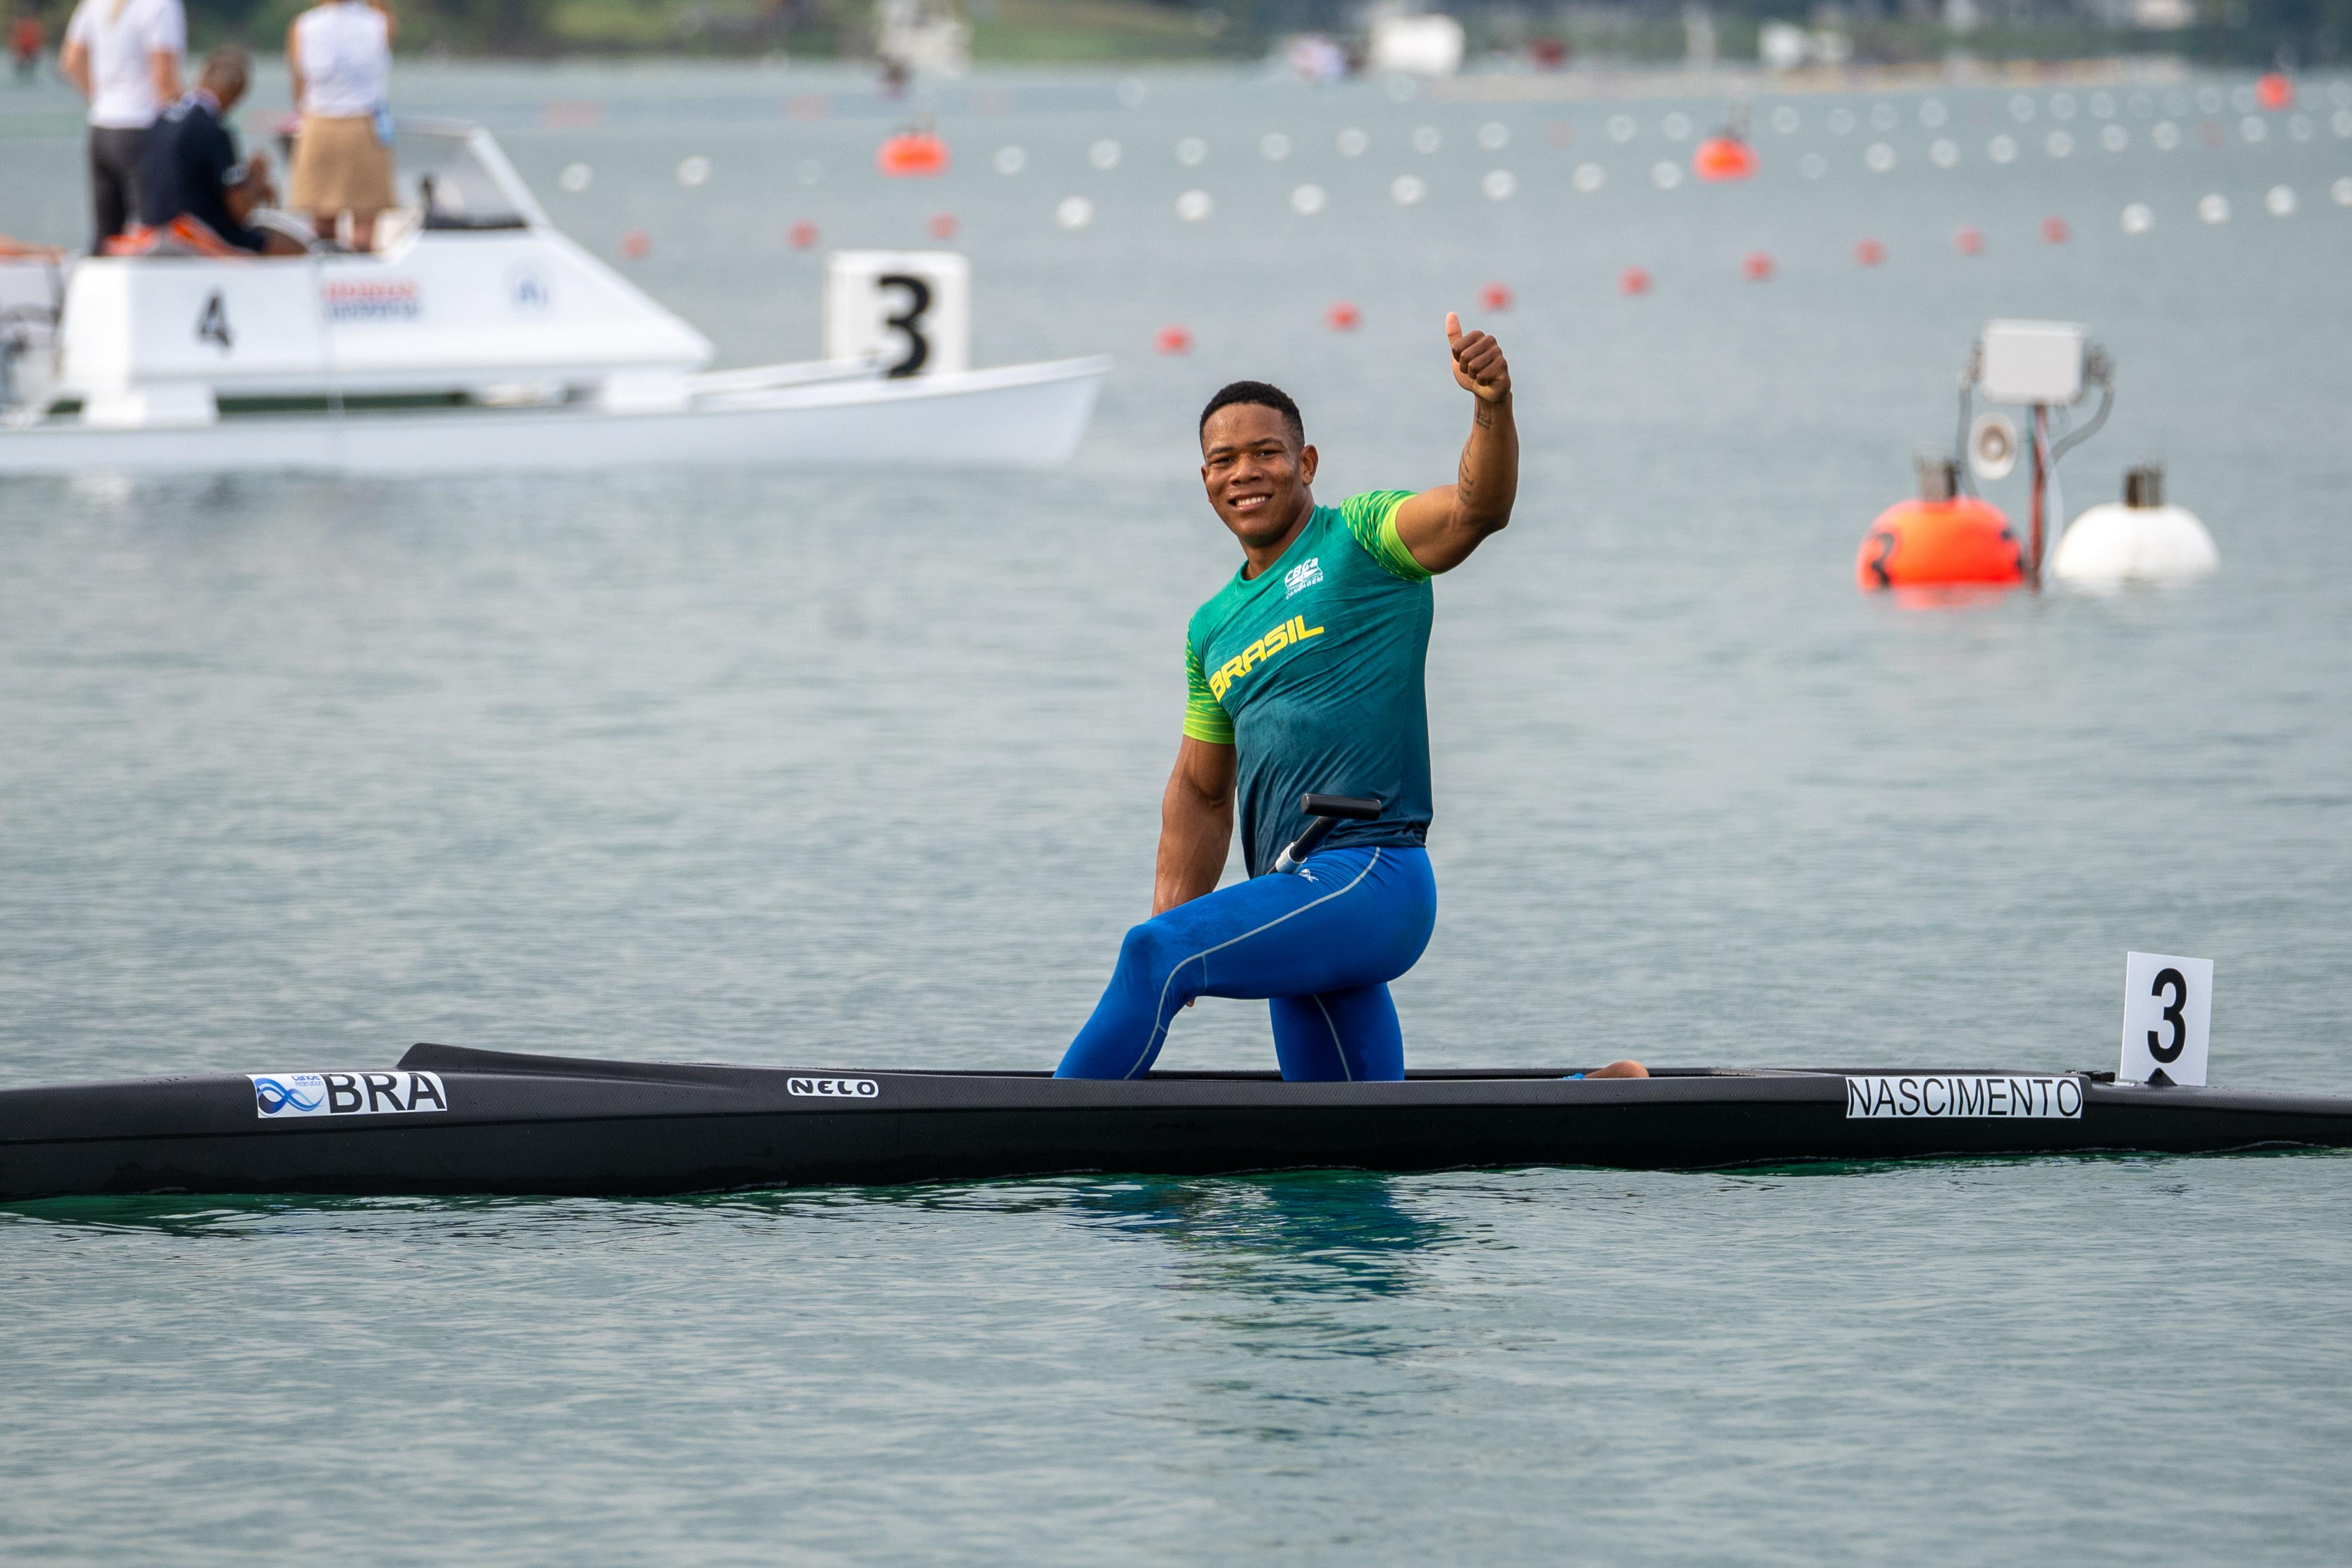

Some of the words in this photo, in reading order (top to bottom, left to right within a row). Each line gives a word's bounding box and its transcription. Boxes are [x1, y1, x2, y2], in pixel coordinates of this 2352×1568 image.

[195, 293, 232, 349] 4
[877, 275, 932, 379] 3
[1209, 614, 1325, 703] BRASIL
[2147, 967, 2187, 1064] 3
[319, 1074, 447, 1114] BRA
[791, 1079, 875, 1095] NELO
[1848, 1078, 2082, 1117] NASCIMENTO
